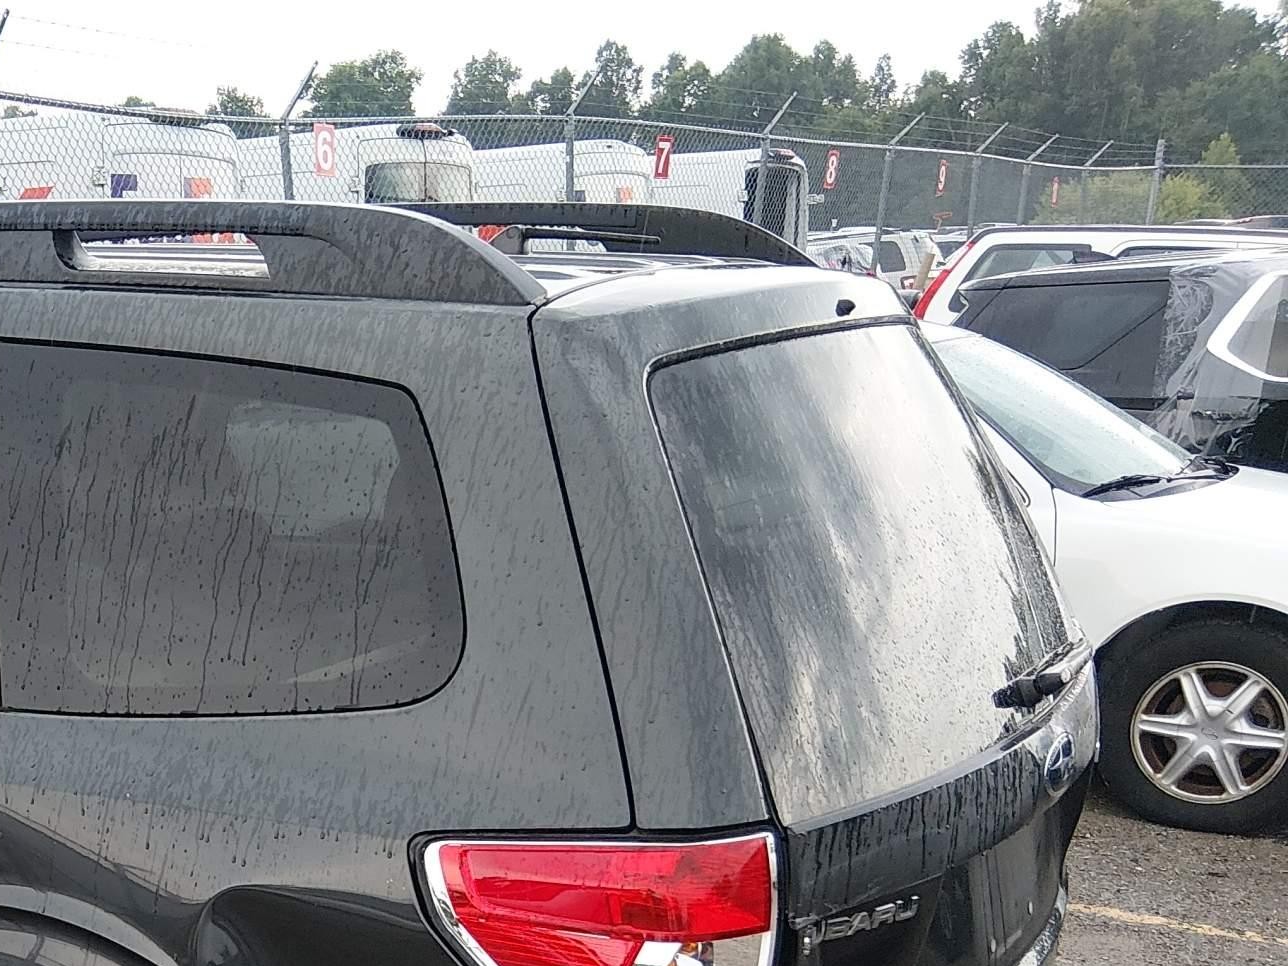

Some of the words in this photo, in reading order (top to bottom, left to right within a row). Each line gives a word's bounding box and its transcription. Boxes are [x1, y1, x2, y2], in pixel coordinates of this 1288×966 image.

[317, 130, 333, 171] 6
[658, 141, 671, 174] 7
[825, 155, 837, 184] 8
[937, 165, 946, 192] 9
